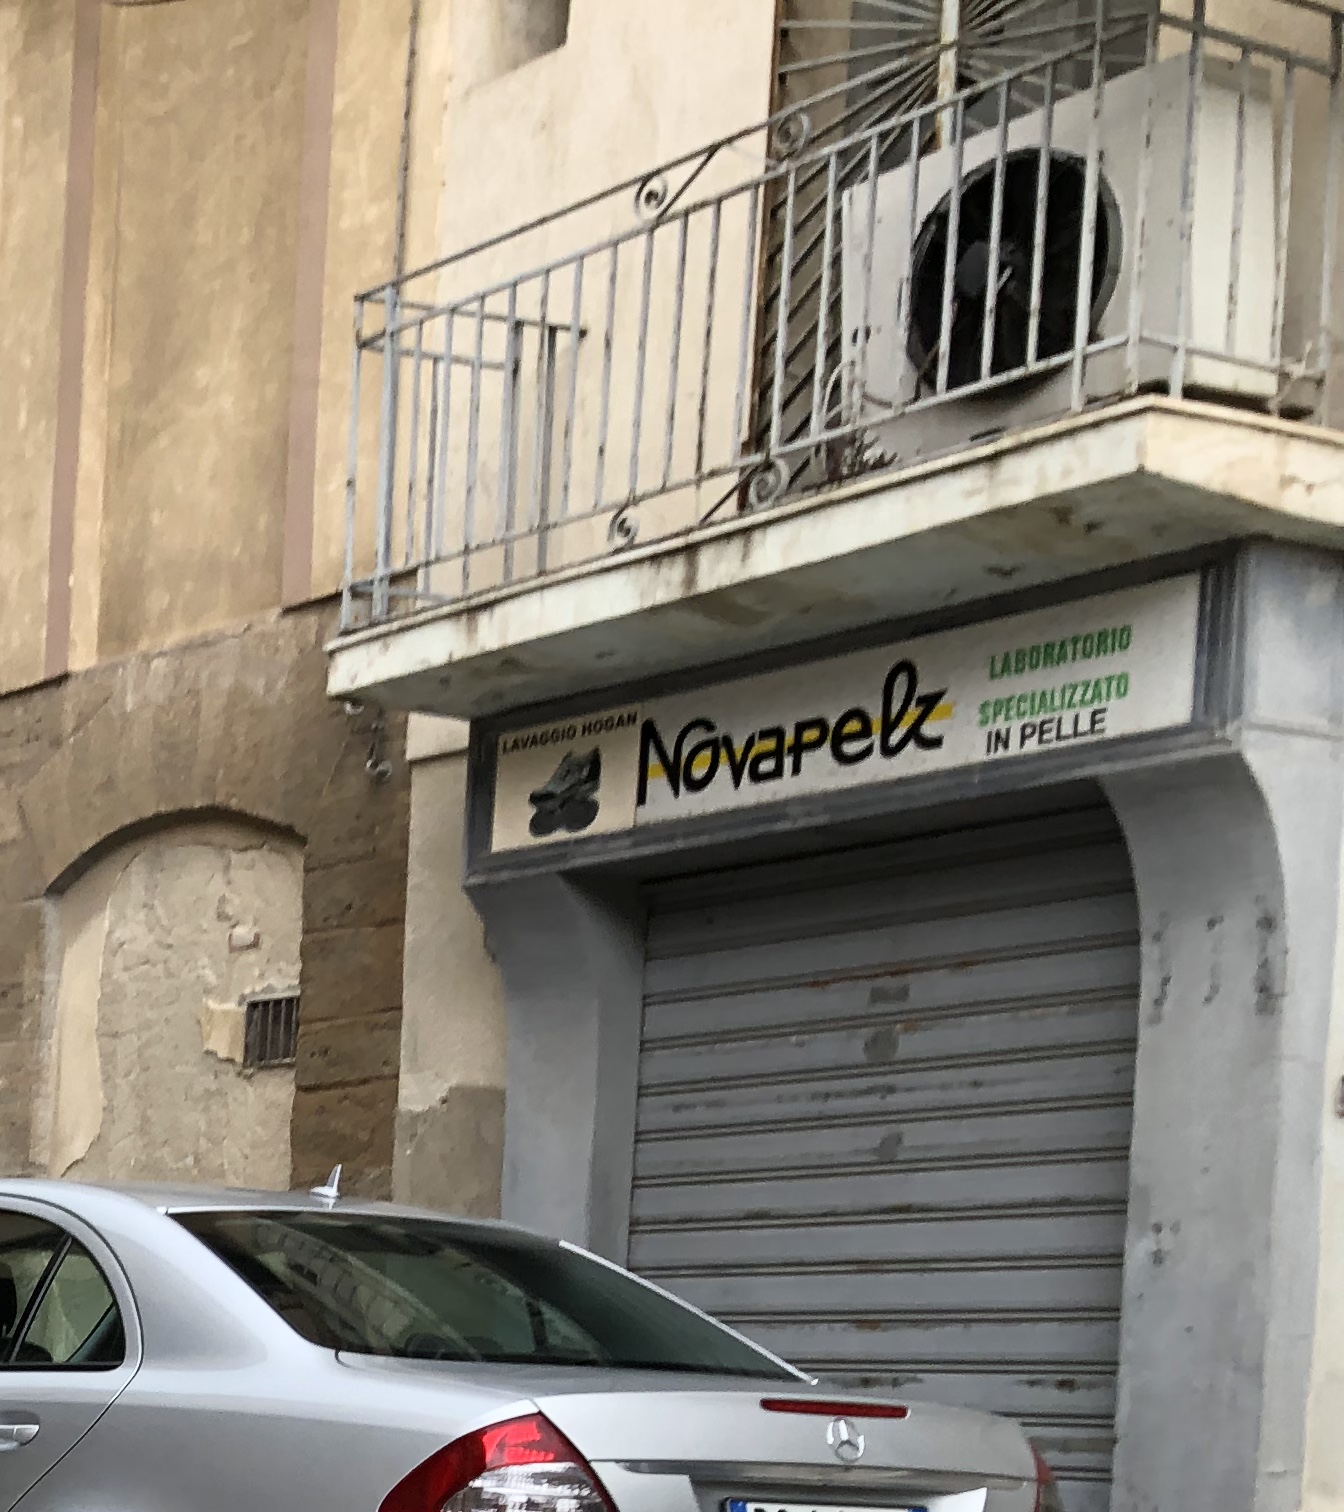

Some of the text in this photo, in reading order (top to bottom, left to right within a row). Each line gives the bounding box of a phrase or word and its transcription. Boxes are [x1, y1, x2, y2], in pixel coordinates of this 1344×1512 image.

[988, 623, 1133, 681] LABORATORIO
[977, 671, 1130, 727] SPECIALIZZATO
[501, 711, 638, 753] LAVAGGIO HOGAN
[985, 707, 1108, 756] IN PELLE
